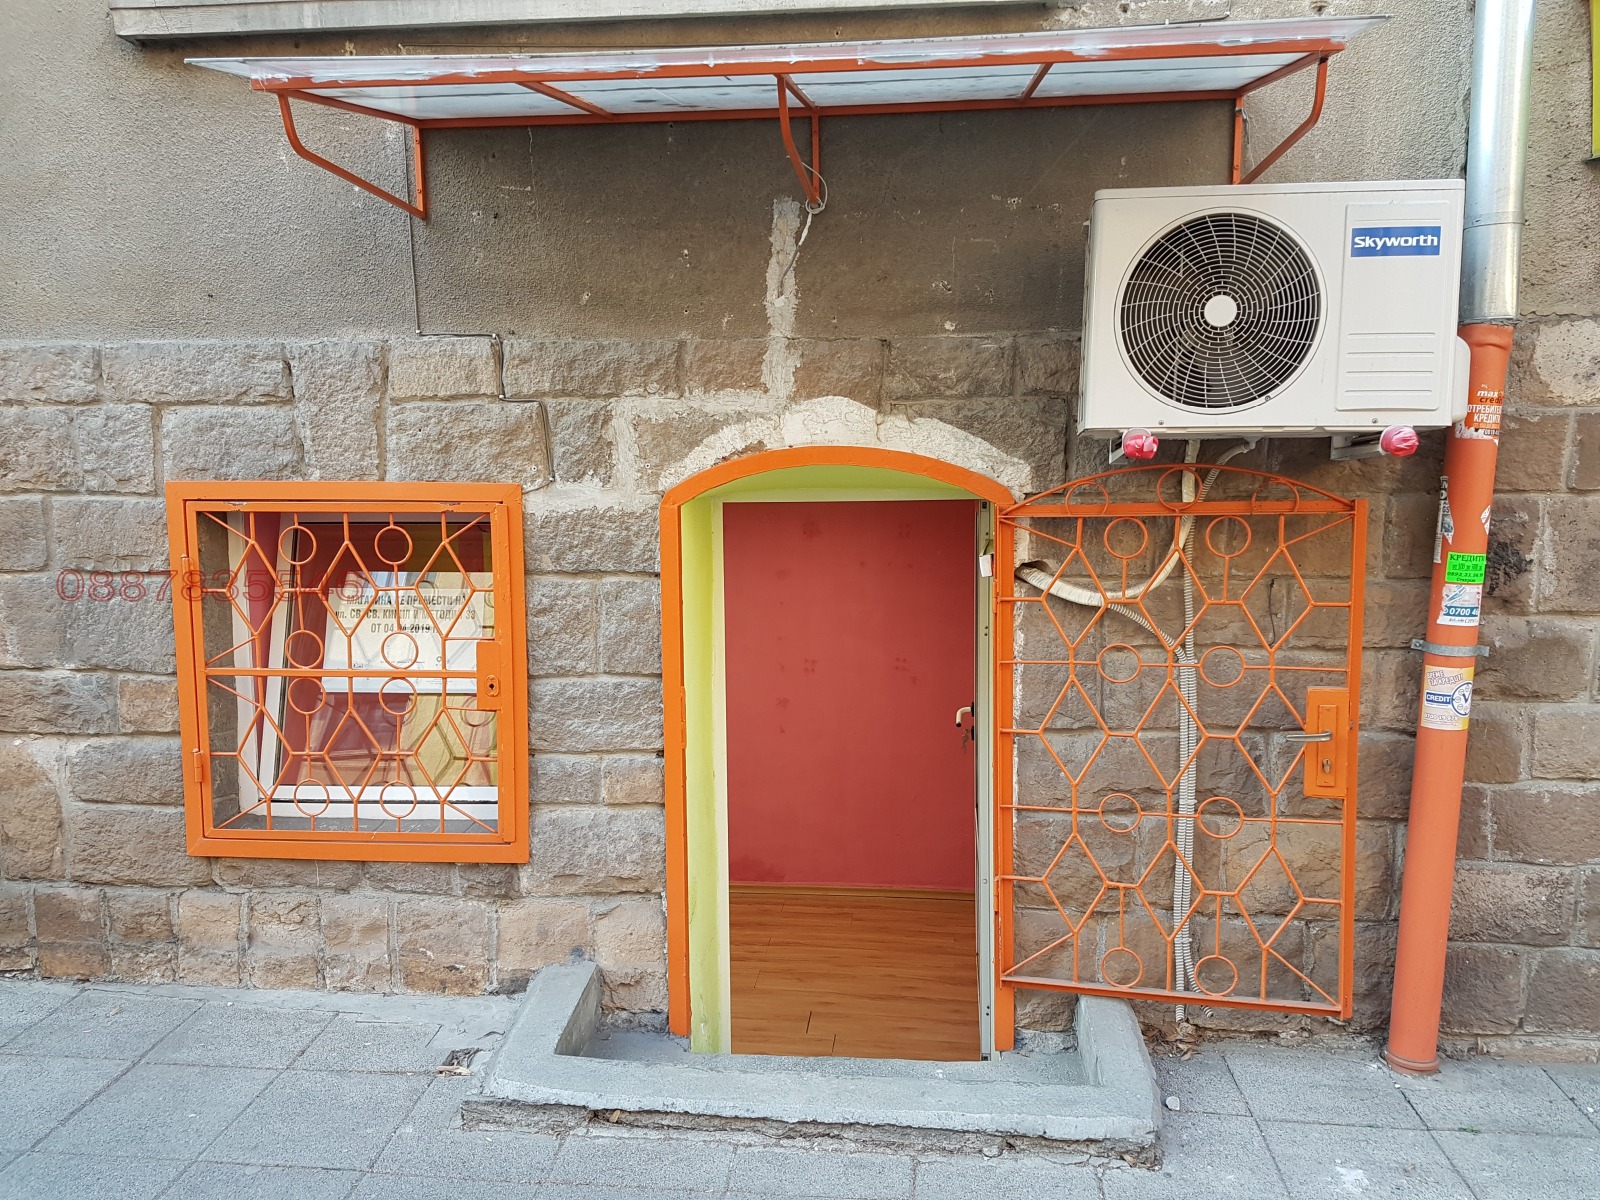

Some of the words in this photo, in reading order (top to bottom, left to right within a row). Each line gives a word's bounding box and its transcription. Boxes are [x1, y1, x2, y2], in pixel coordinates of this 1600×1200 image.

[1353, 234, 1439, 250] Skyworth
[347, 595, 392, 605] МАГАИНА
[350, 609, 362, 619] СВ
[383, 609, 410, 619] КИИЛ
[422, 609, 463, 620] МТОДИ
[1450, 608, 1471, 616] 0700
[371, 623, 381, 633] ОТ
[1426, 694, 1451, 703] CREDIT
